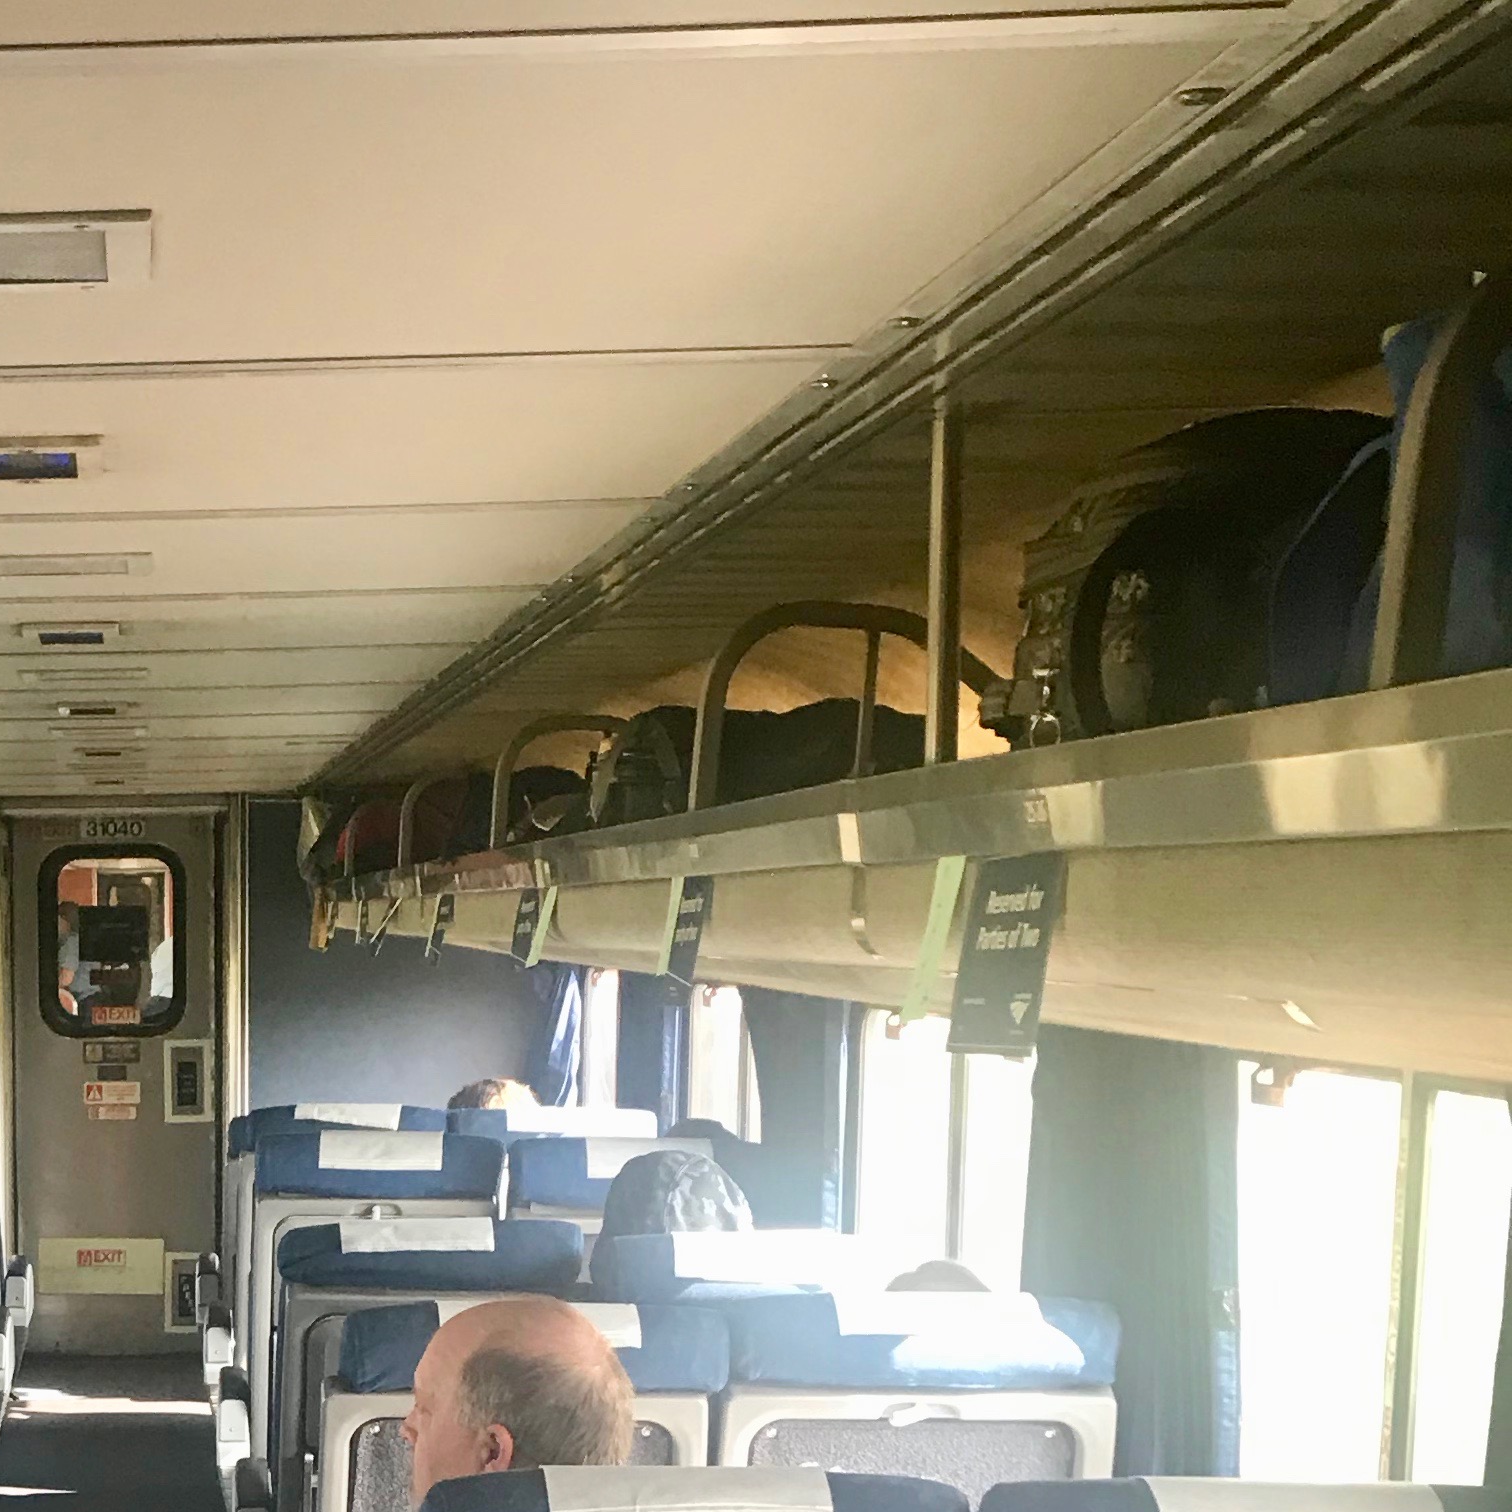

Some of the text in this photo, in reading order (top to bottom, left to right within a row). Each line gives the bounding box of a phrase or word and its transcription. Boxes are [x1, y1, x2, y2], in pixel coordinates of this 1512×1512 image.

[86, 821, 143, 836] 31040
[108, 1009, 136, 1021] EXIT
[93, 1249, 123, 1263] EXIT
